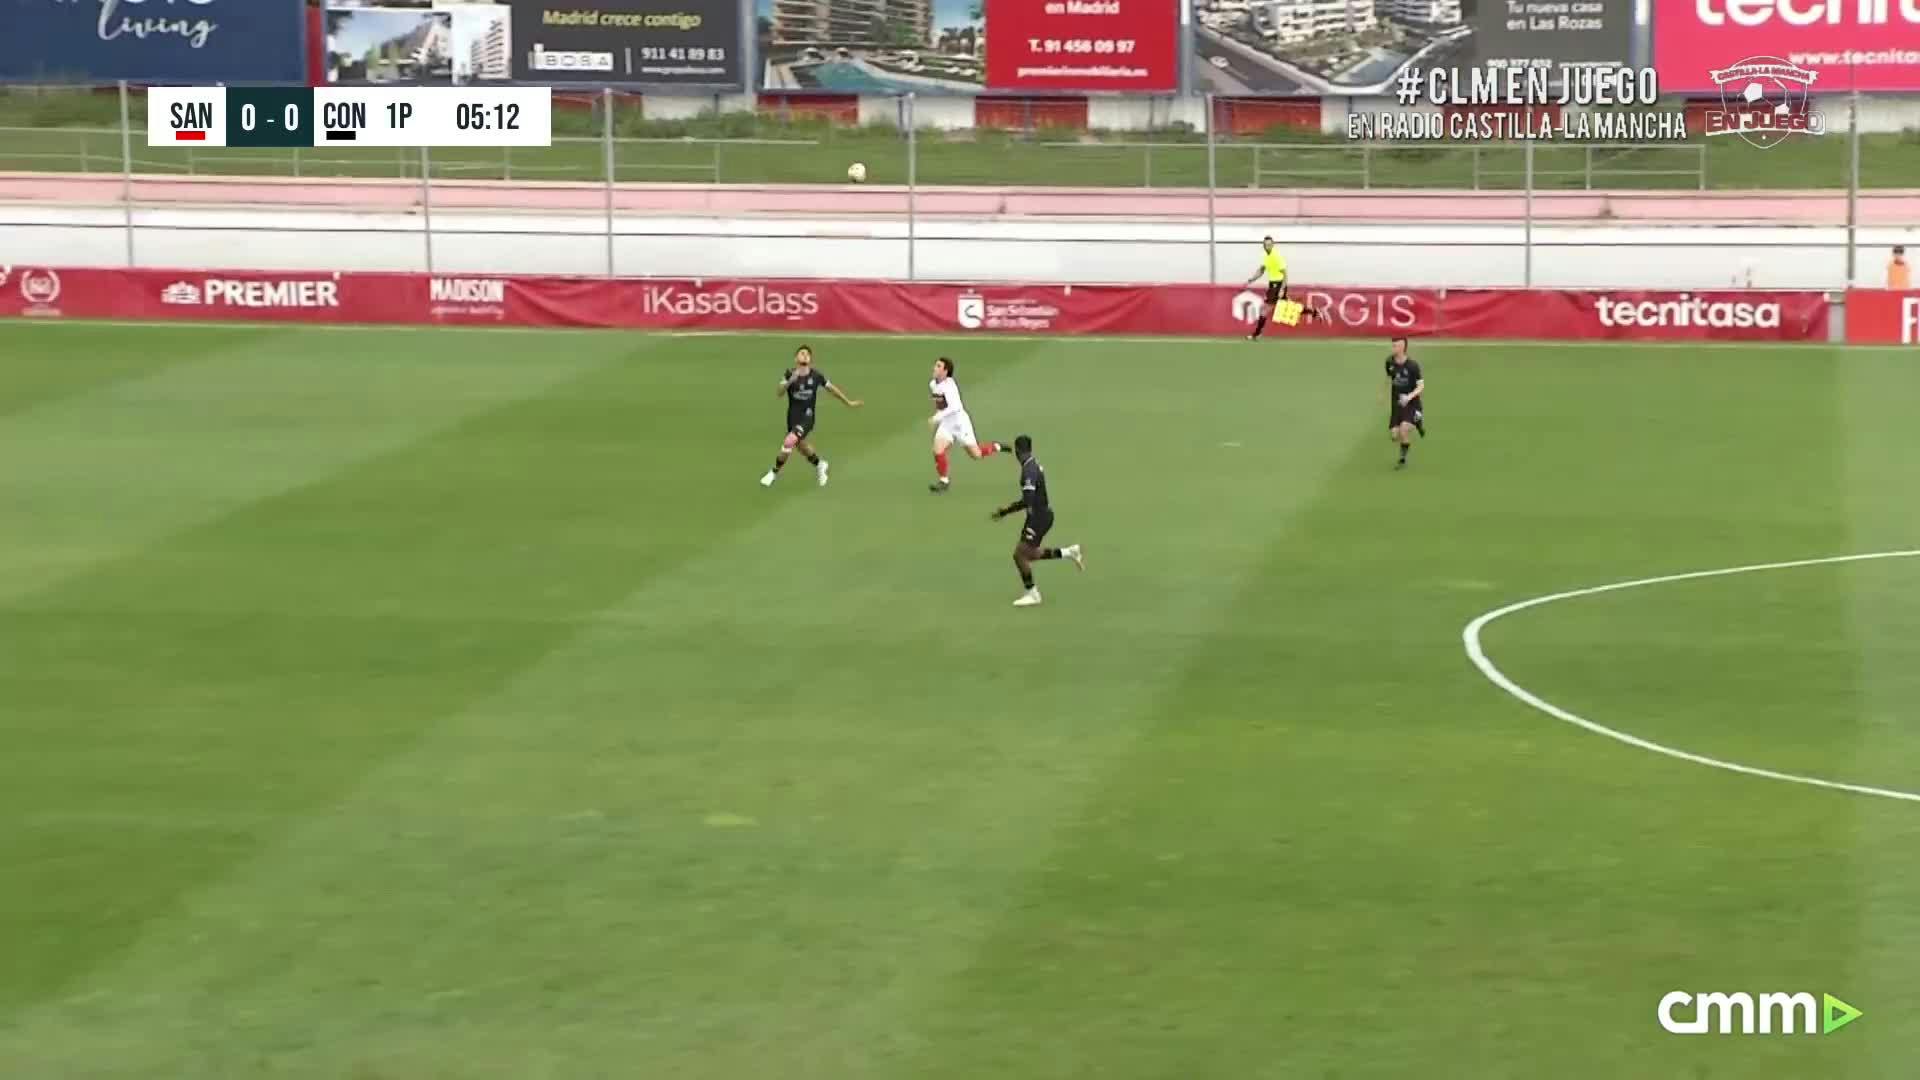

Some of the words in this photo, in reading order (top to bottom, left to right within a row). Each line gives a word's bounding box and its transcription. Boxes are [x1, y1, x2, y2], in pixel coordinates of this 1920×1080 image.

[1045, 3, 1065, 14] en
[1067, 1, 1120, 14] Madrid
[1526, 4, 1569, 13] nueva
[1571, 3, 1603, 13] casa
[543, 9, 598, 25] Madrid
[600, 14, 642, 26] crece
[644, 12, 701, 30] contigo
[1506, 19, 1527, 30] en
[1529, 16, 1555, 30] Las
[1558, 16, 1603, 30] Rozas
[204, 280, 338, 307] PREMIER
[430, 279, 504, 302] MADISON
[643, 286, 818, 315] iKasaClass
[1594, 294, 1780, 328] tecnitasa
